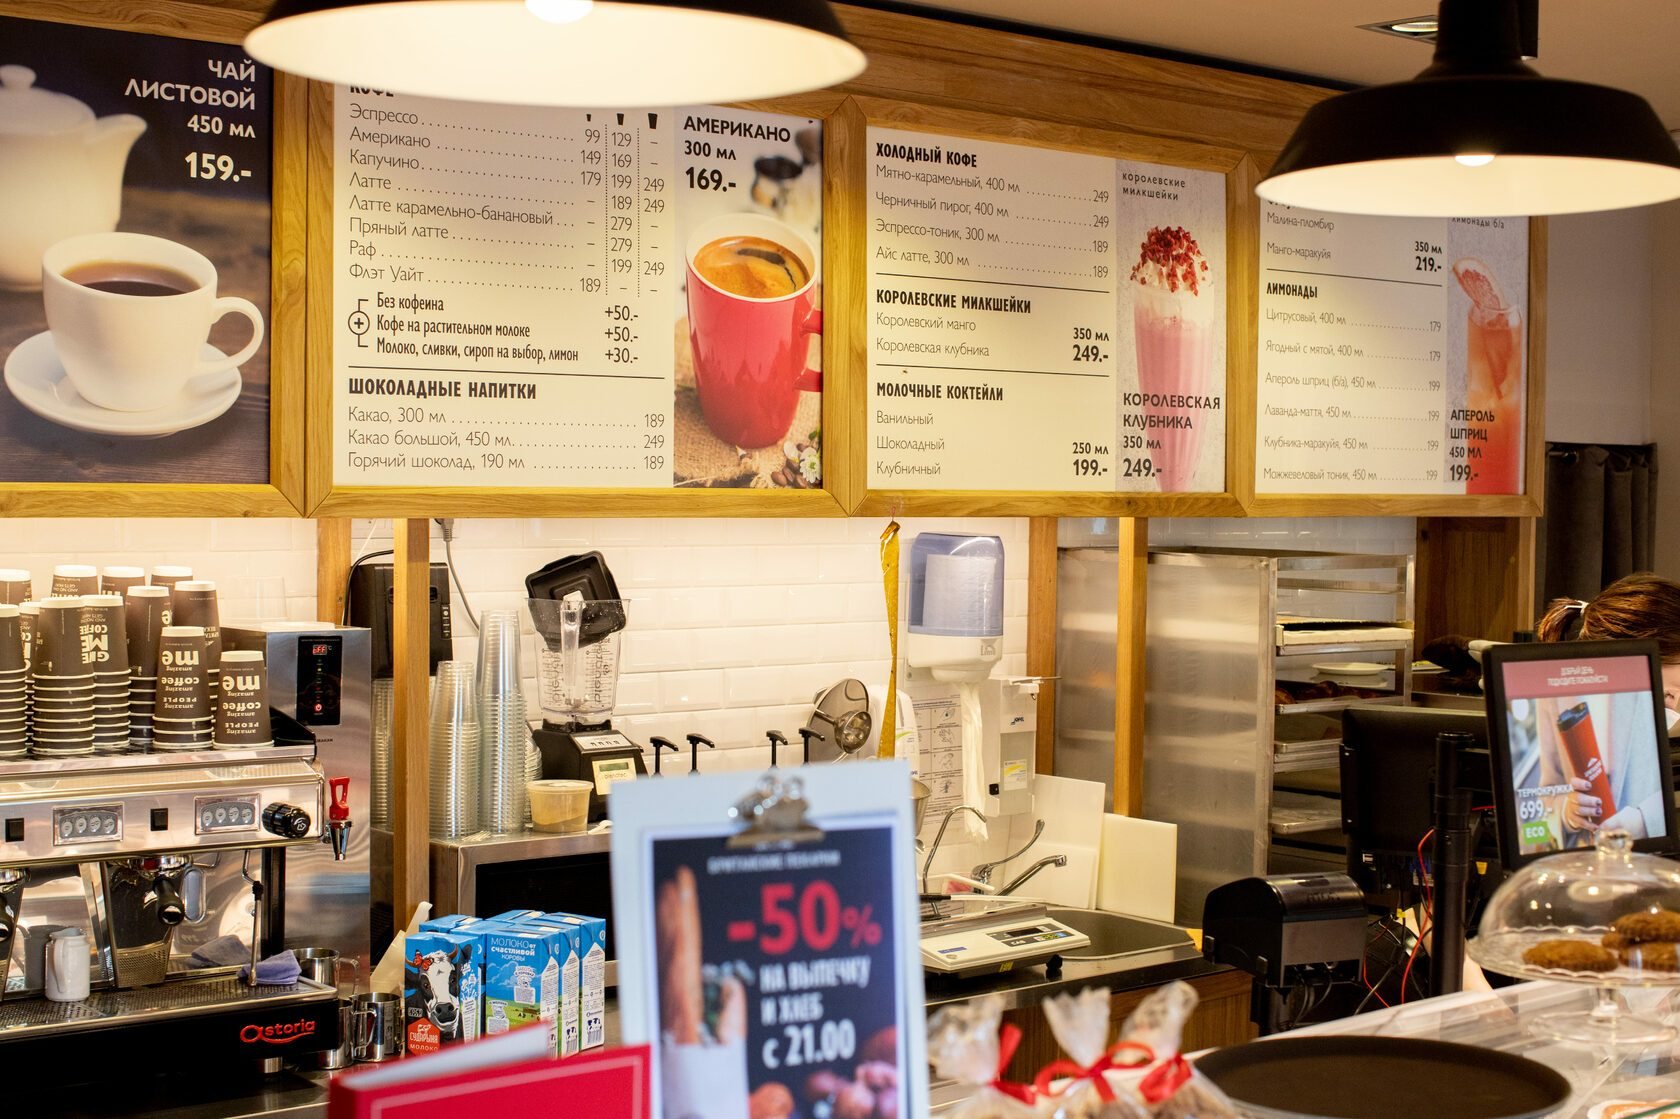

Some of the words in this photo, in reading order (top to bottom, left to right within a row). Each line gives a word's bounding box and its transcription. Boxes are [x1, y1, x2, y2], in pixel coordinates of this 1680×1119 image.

[208, 59, 255, 82] ЧАЙ
[125, 79, 255, 110] ЛИСТОВОЙ
[188, 115, 223, 134] 450
[230, 123, 255, 138] мл
[350, 103, 418, 125] Эспрессо
[585, 129, 600, 143] 99
[612, 132, 631, 147] 129
[684, 116, 790, 142] АМЕРИКАНО
[350, 126, 430, 148] Американо
[581, 150, 601, 165] 149
[612, 153, 631, 168] 169
[685, 140, 711, 157] 300
[717, 148, 736, 160] мл
[876, 143, 941, 163] ХОЛОДНЫЙ
[947, 151, 976, 167] КОФЕ
[185, 152, 251, 182] 159.-
[351, 149, 419, 170] Капучино
[581, 171, 601, 186] 179
[612, 174, 632, 189] 199
[644, 177, 664, 192] 249
[686, 167, 736, 192] 169.-
[877, 164, 982, 189] Мятно-карамельный,
[986, 177, 1005, 191] 400
[1008, 184, 1020, 192] мл
[1093, 190, 1109, 203] 249
[1123, 173, 1185, 188] королевские
[349, 172, 391, 189] Латте
[612, 195, 632, 210] 189
[644, 198, 664, 213] 249
[1123, 187, 1178, 200] милкшейки
[349, 195, 391, 212] Латте
[397, 203, 552, 225] карамельно-банановый
[611, 216, 632, 231] 279
[876, 192, 936, 209] Черничный
[940, 202, 971, 215] пирог,
[974, 202, 993, 215] 400
[997, 208, 1009, 217] мл
[1093, 215, 1109, 228] 249
[1267, 212, 1334, 232] Малина-пломбир
[350, 217, 406, 237] Пряный
[412, 227, 448, 239] латте
[611, 237, 632, 252] 279
[876, 218, 961, 240] Эспрессо-тоник,
[966, 227, 984, 241] 300
[988, 233, 999, 242] мл
[1093, 240, 1108, 253] 189
[1267, 242, 1331, 261] Манго-маракуйя
[1415, 241, 1429, 252] 350
[1431, 246, 1442, 254] мл
[350, 240, 376, 260] Раф
[612, 259, 632, 273] 199
[644, 261, 664, 276] 249
[876, 246, 897, 260] Айс
[901, 252, 930, 264] латте,
[935, 251, 953, 264] 300
[957, 257, 969, 266] мл
[1093, 266, 1108, 278] 189
[1416, 256, 1441, 272] 219.-
[350, 263, 385, 279] Флэт
[390, 265, 424, 282] Уайт
[580, 278, 601, 292] 189
[877, 289, 956, 308] КОРОЛЕВСКИЕ
[962, 296, 1030, 313] МИЛКШЕЙКИ
[1267, 283, 1317, 299] ЛИМОНАДЫ
[378, 292, 395, 308] Без
[399, 294, 444, 314] кофеина
[605, 305, 638, 321] +50.-
[377, 315, 404, 336] Кофе
[408, 321, 420, 332] на
[424, 322, 492, 337] растительном
[496, 325, 530, 337] молоке
[605, 326, 638, 342] +50.-
[877, 312, 943, 329] Королевский
[947, 321, 976, 331] манго
[1319, 312, 1334, 324] 400
[1430, 321, 1441, 332] 179
[1074, 328, 1091, 340] 350
[1095, 332, 1109, 341] мл
[377, 337, 418, 356] Молоко,
[422, 344, 460, 358] сливки,
[464, 346, 493, 362] сироп
[497, 348, 509, 358] на
[513, 344, 545, 364] выбор,
[549, 350, 578, 360] лимон
[605, 348, 638, 363] +30.-
[877, 338, 941, 354] Королевская
[945, 342, 989, 358] клубника
[1073, 344, 1108, 362] 249.-
[1266, 340, 1300, 354] Ягодный
[1337, 345, 1352, 356] 400
[1429, 351, 1440, 361] 179
[349, 378, 461, 399] ШОКОЛАДНЫЕ
[469, 382, 536, 399] НАПИТКИ
[877, 383, 941, 398] МОЛОЧНЫЕ
[947, 384, 1002, 400] КОКТЕЙЛИ
[1124, 393, 1220, 409] КОРОЛЕВСКАЯ
[349, 406, 391, 423] Какао,
[398, 407, 424, 422] 300
[429, 413, 446, 423] мл
[645, 414, 664, 428] 189
[877, 410, 933, 424] Ванильный
[1124, 414, 1192, 430] КЛУБНИКА
[1451, 409, 1494, 422] АПЕРОЛЬ
[349, 429, 389, 444] Какао
[395, 430, 460, 447] большой,
[466, 432, 490, 446] 450
[495, 437, 511, 446] мл
[644, 435, 664, 448] 249
[877, 436, 944, 451] Шоколадный
[1123, 435, 1142, 448] 350
[1147, 440, 1161, 449] мл
[1450, 428, 1487, 442] ШПРИЦ
[1073, 442, 1091, 454] 250
[1095, 446, 1108, 454] мл
[1449, 446, 1464, 458] 450
[349, 452, 405, 471] Горячий
[412, 457, 475, 470] шоколад,
[481, 454, 503, 468] 190
[509, 459, 524, 468] мл
[644, 456, 664, 469] 189
[877, 461, 940, 477] Клубничный
[1073, 459, 1107, 476] 199.-
[1123, 458, 1162, 477] 249.-
[1450, 465, 1478, 481] 199.-
[222, 675, 260, 691] me
[223, 702, 261, 711] coffee
[1517, 784, 1574, 798] ТЕРМОКРУЖКА
[1526, 827, 1545, 838] ECO
[491, 938, 529, 948] МОЛОКО
[760, 963, 785, 993] НА
[784, 1019, 855, 1067] 21.00
